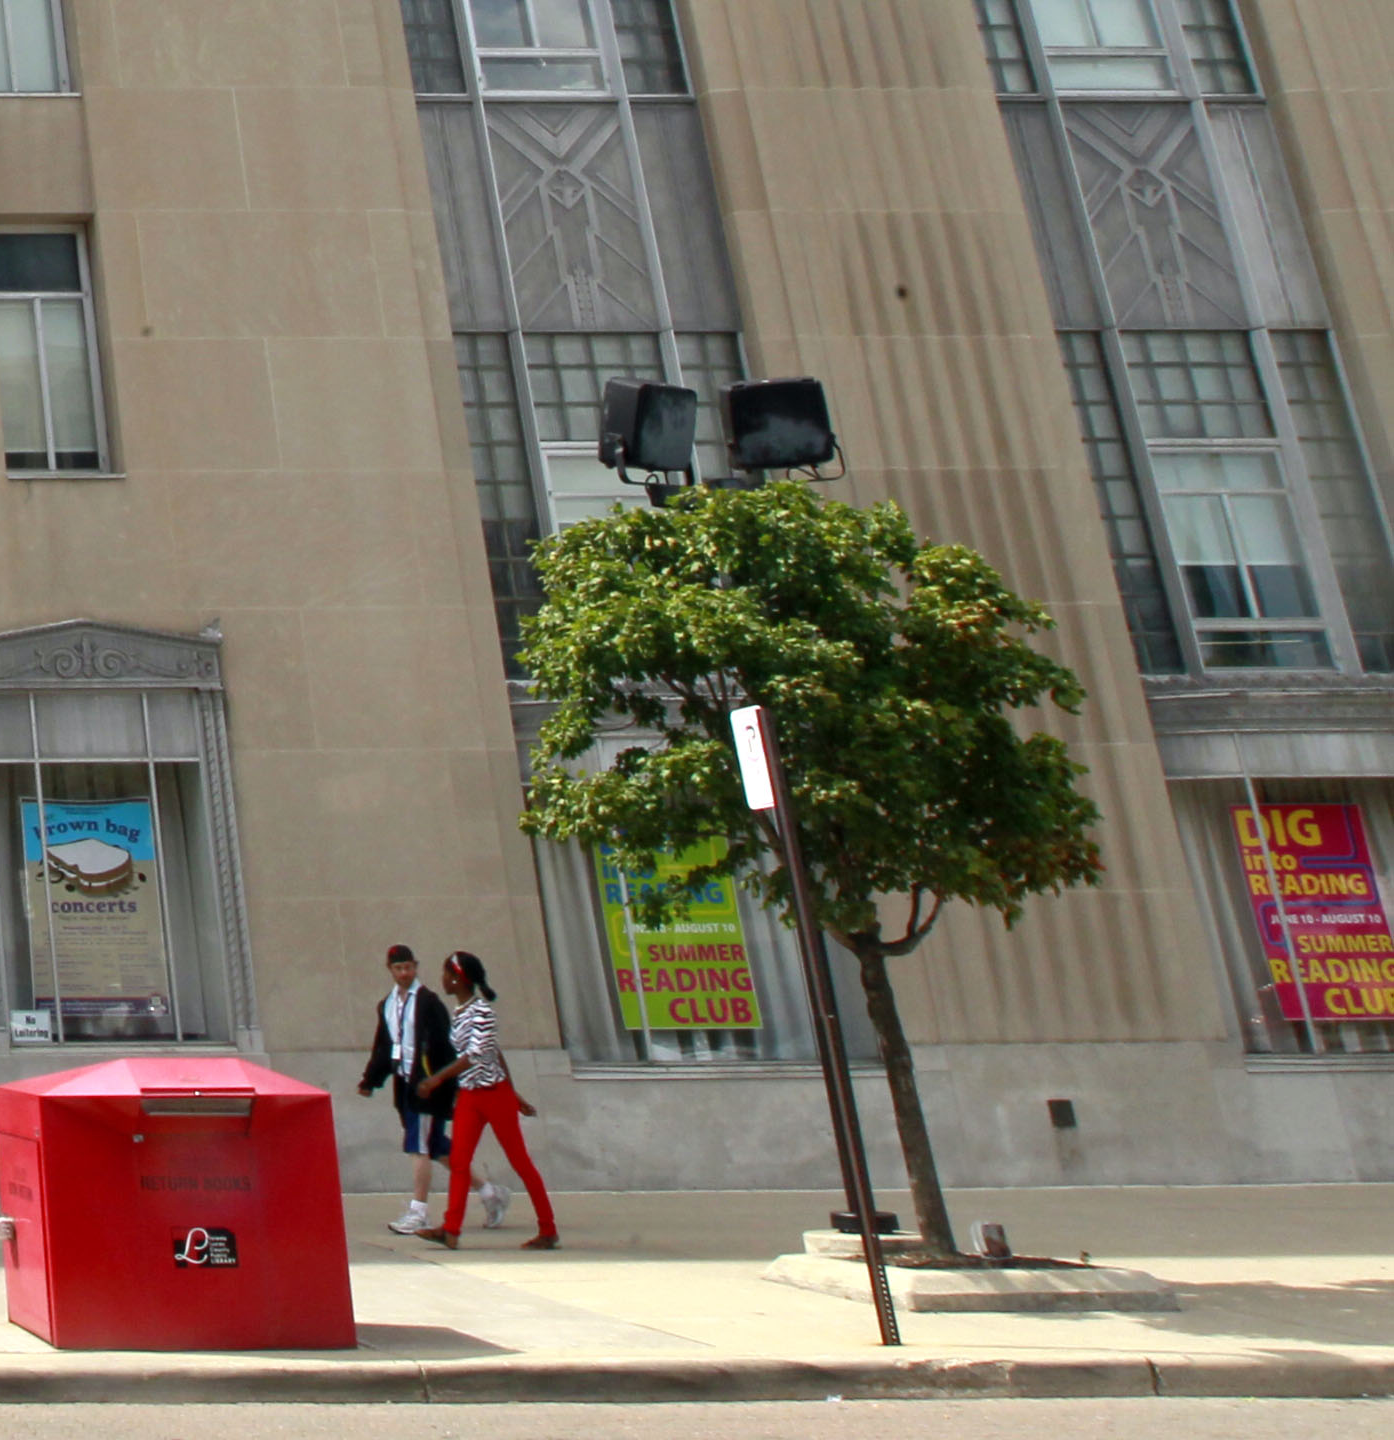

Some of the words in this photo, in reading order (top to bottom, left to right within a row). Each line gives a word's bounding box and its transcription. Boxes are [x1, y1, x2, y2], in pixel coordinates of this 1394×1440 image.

[105, 819, 141, 843] bag
[1234, 809, 1324, 847] DIG
[1243, 848, 1297, 871] into
[1247, 873, 1368, 896] READING
[50, 901, 137, 913] concerts
[1302, 914, 1314, 924] 10
[1322, 913, 1366, 924] AUGUST
[1368, 914, 1382, 924] 10
[674, 922, 720, 934] AUGUST
[722, 923, 736, 934] 10
[647, 944, 746, 962] SUMMER
[1297, 935, 1394, 953] SUMMER
[616, 967, 754, 993] READING
[669, 997, 753, 1024] CLUB
